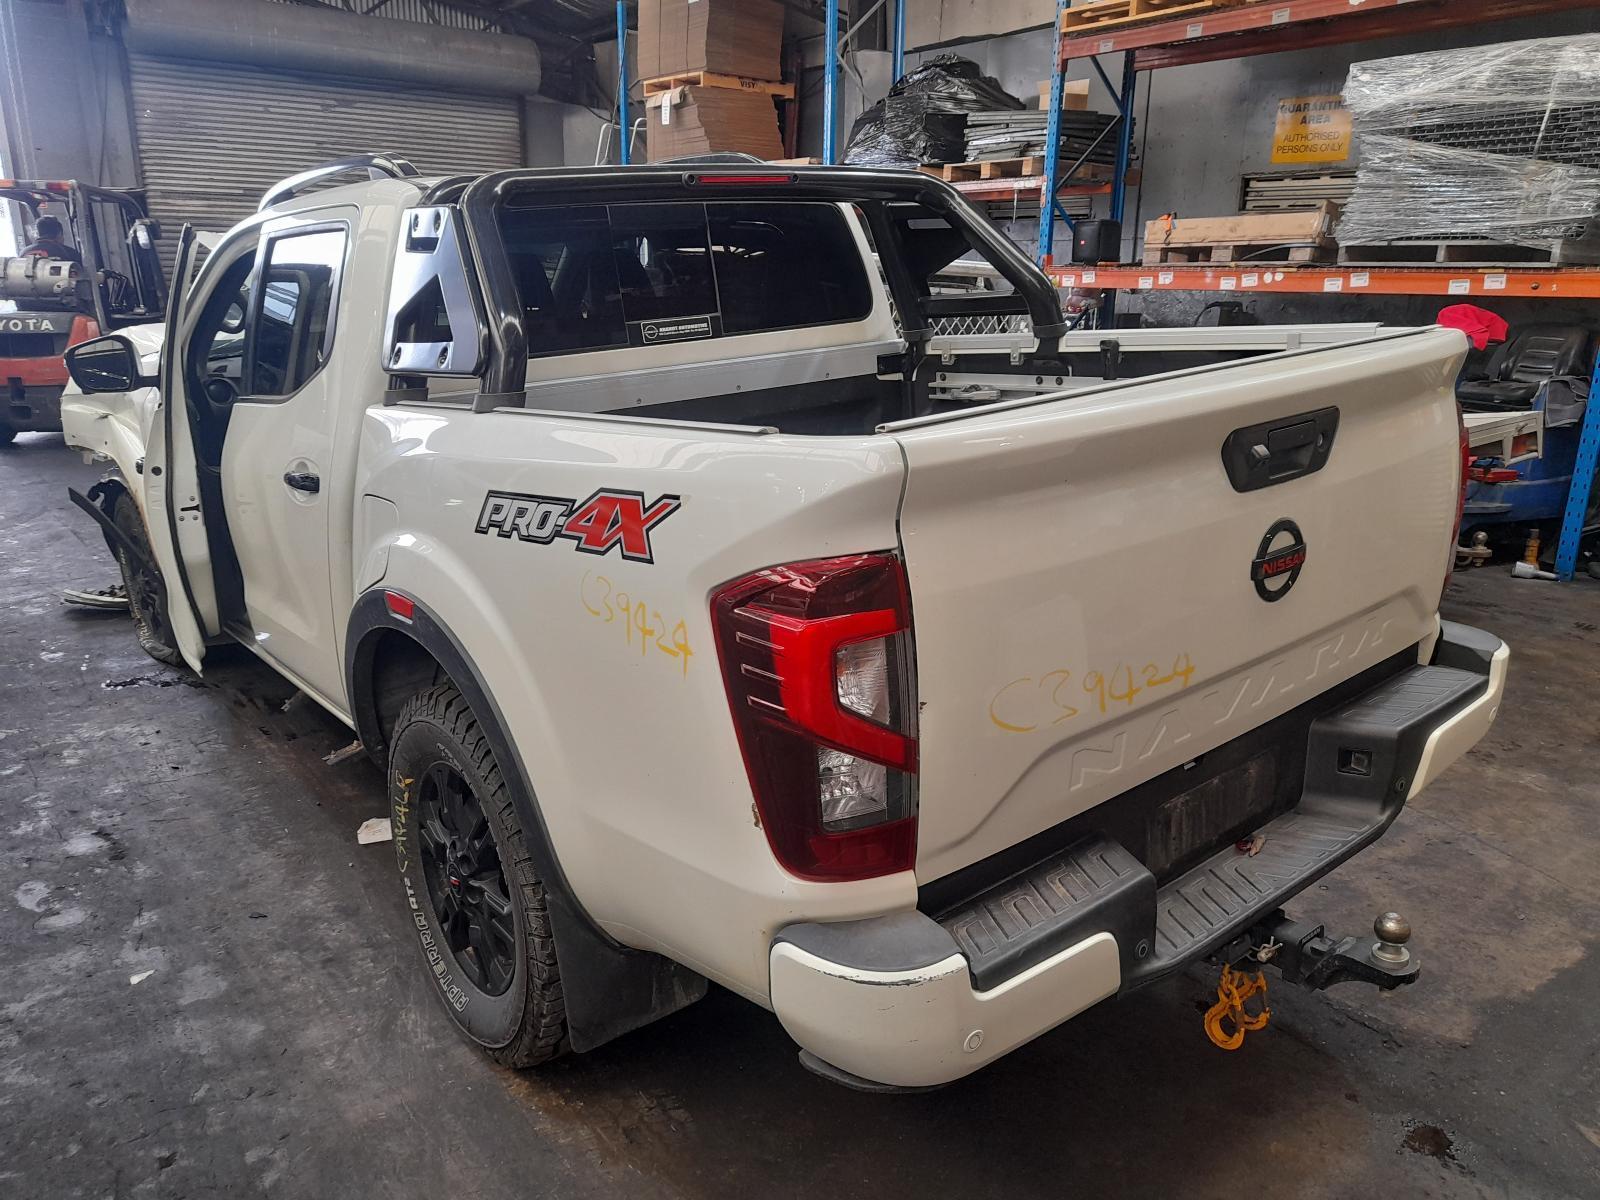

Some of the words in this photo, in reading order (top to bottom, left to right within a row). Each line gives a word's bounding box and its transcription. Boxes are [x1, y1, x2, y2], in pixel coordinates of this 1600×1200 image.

[1300, 115, 1332, 126] AREA
[1276, 144, 1318, 154] PERSONS
[1319, 142, 1344, 153] ONLY
[1283, 131, 1340, 143] AUTHORISED
[475, 487, 682, 565] PRO-4X
[1263, 550, 1306, 576] NISSAN
[988, 653, 1196, 734] C39424
[413, 912, 470, 1013] APTERRA
